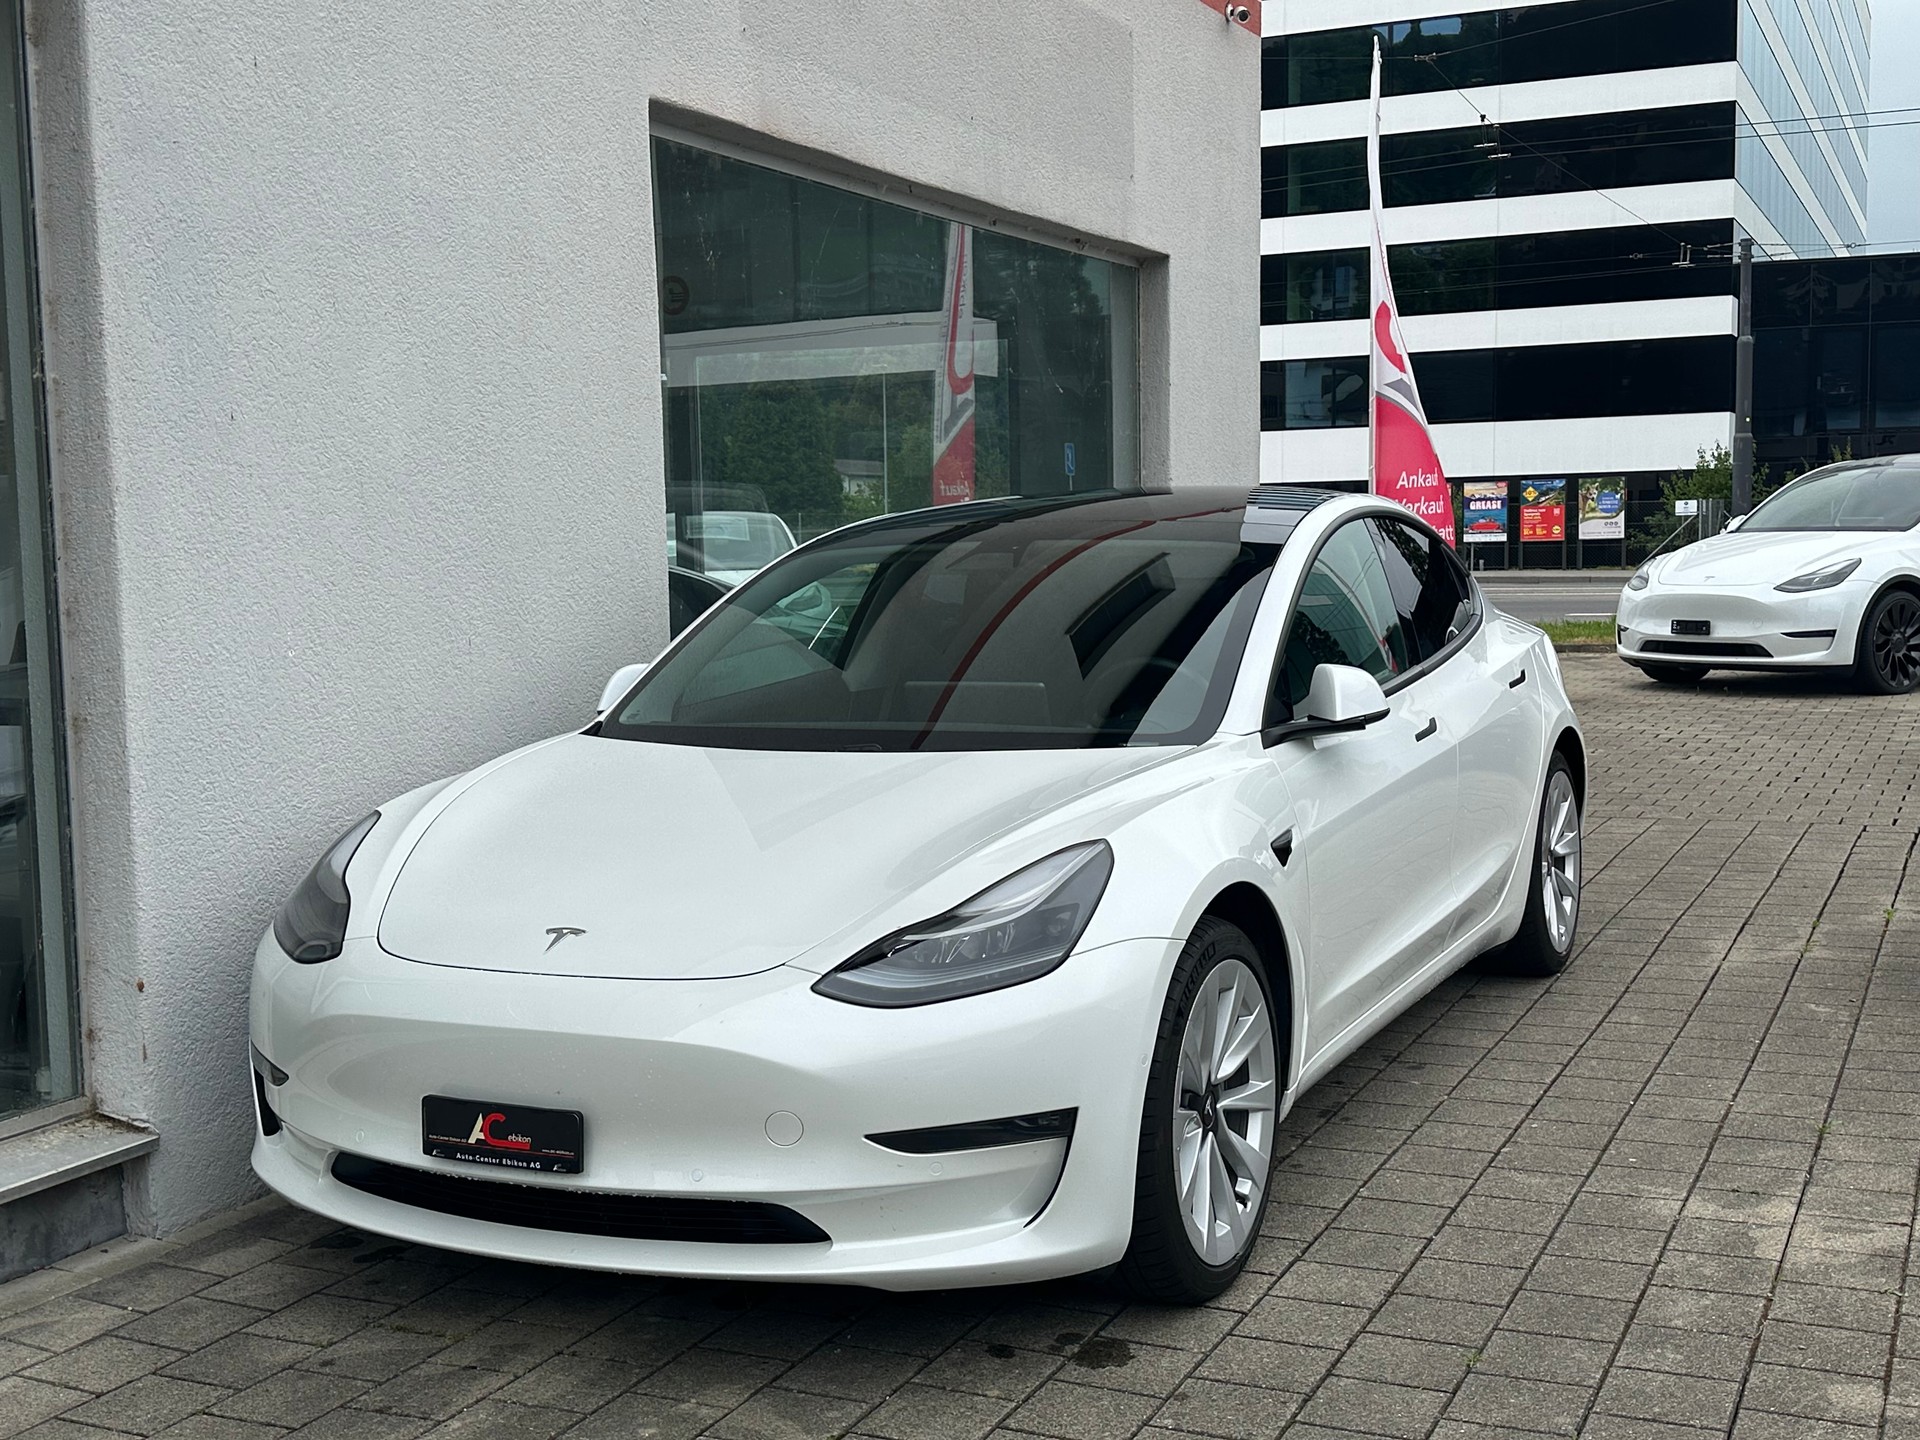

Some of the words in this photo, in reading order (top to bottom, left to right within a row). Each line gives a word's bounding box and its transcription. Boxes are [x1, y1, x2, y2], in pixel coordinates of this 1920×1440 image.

[1396, 467, 1439, 489] Ankauf
[1469, 500, 1502, 510] GREASE
[508, 1133, 532, 1144] ebikon
[502, 1158, 527, 1168] Ebikon
[530, 1161, 541, 1169] AG
